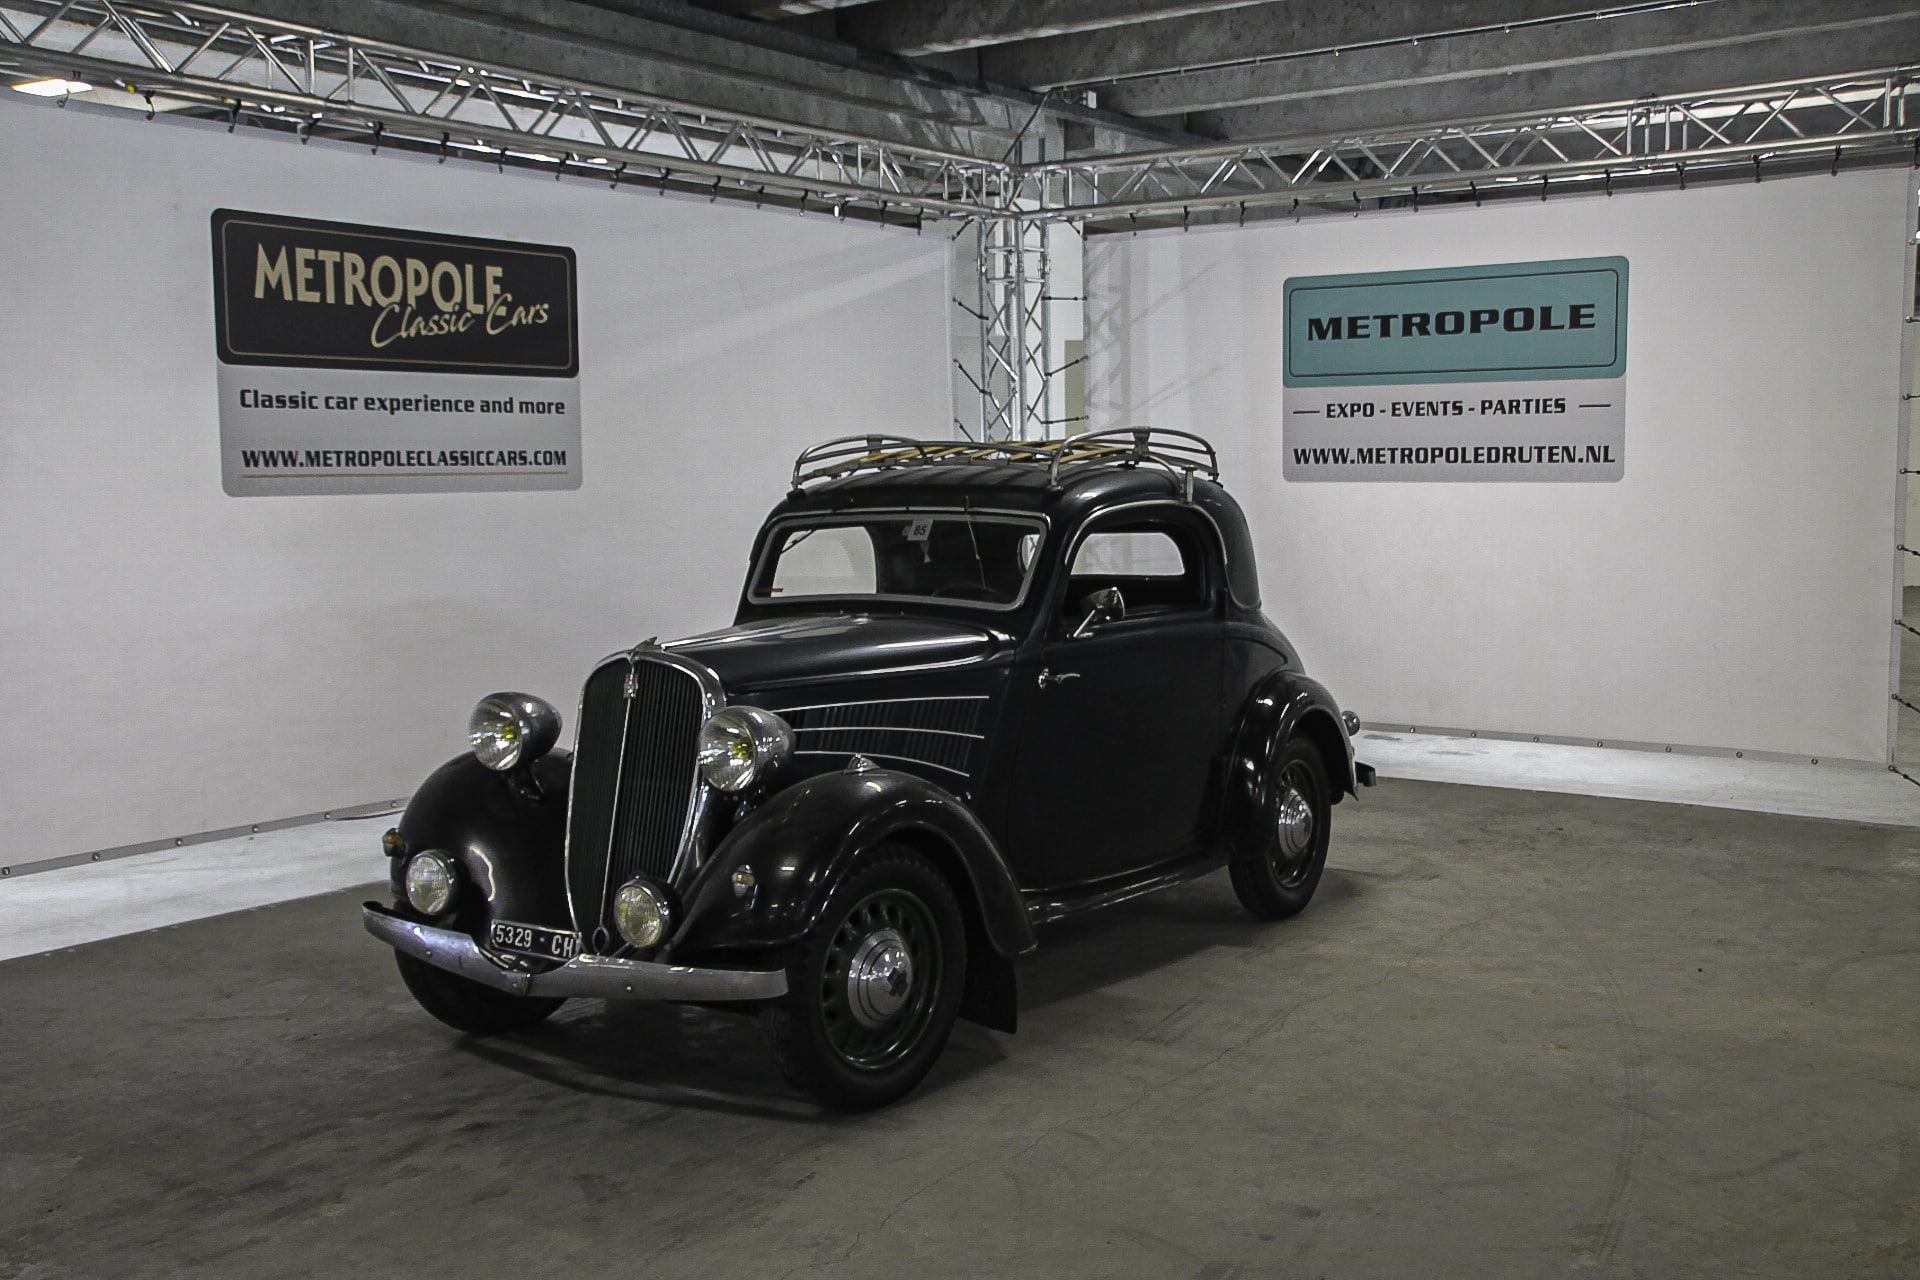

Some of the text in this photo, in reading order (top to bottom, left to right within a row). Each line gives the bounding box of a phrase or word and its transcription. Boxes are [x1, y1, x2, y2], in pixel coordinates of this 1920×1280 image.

[254, 243, 507, 316] METROPOLE
[371, 293, 549, 348] Classic Cars
[1308, 303, 1596, 341] METROPOLE
[239, 389, 566, 415] Classic car experience and more
[1326, 402, 1375, 418] EXPO
[1391, 400, 1463, 417] EVENTS
[1480, 397, 1566, 415] PARTIES
[242, 450, 567, 468] WWW.METROPOLECLASSICCARS.COM
[1293, 445, 1616, 464] WWW.METROPOLEDRUTEN.NL
[495, 924, 574, 958] 5329 CH
